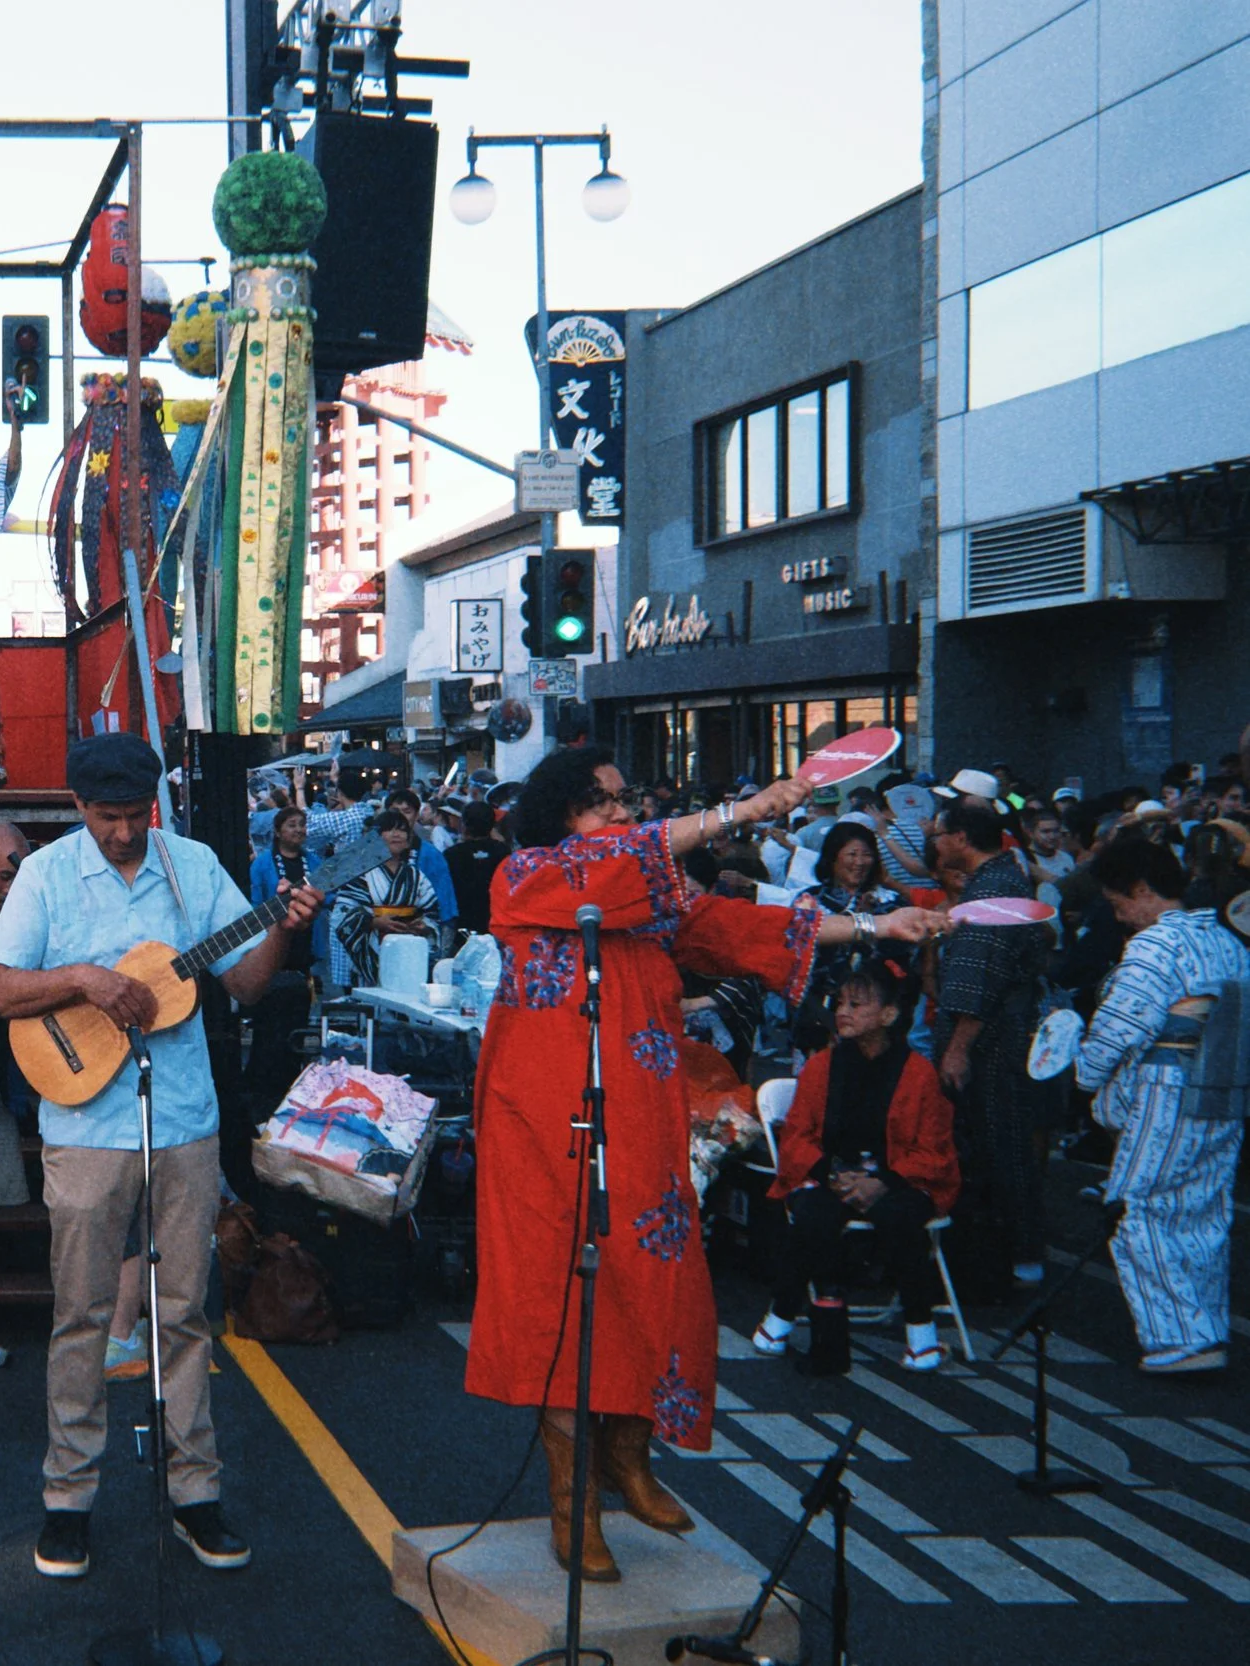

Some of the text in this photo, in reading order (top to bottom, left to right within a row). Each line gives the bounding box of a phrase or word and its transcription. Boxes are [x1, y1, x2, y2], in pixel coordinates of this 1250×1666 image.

[557, 378, 622, 517] 文化堂
[781, 558, 830, 585] GIFTS
[803, 588, 852, 614] MUSIC
[470, 604, 492, 669] おみやげ
